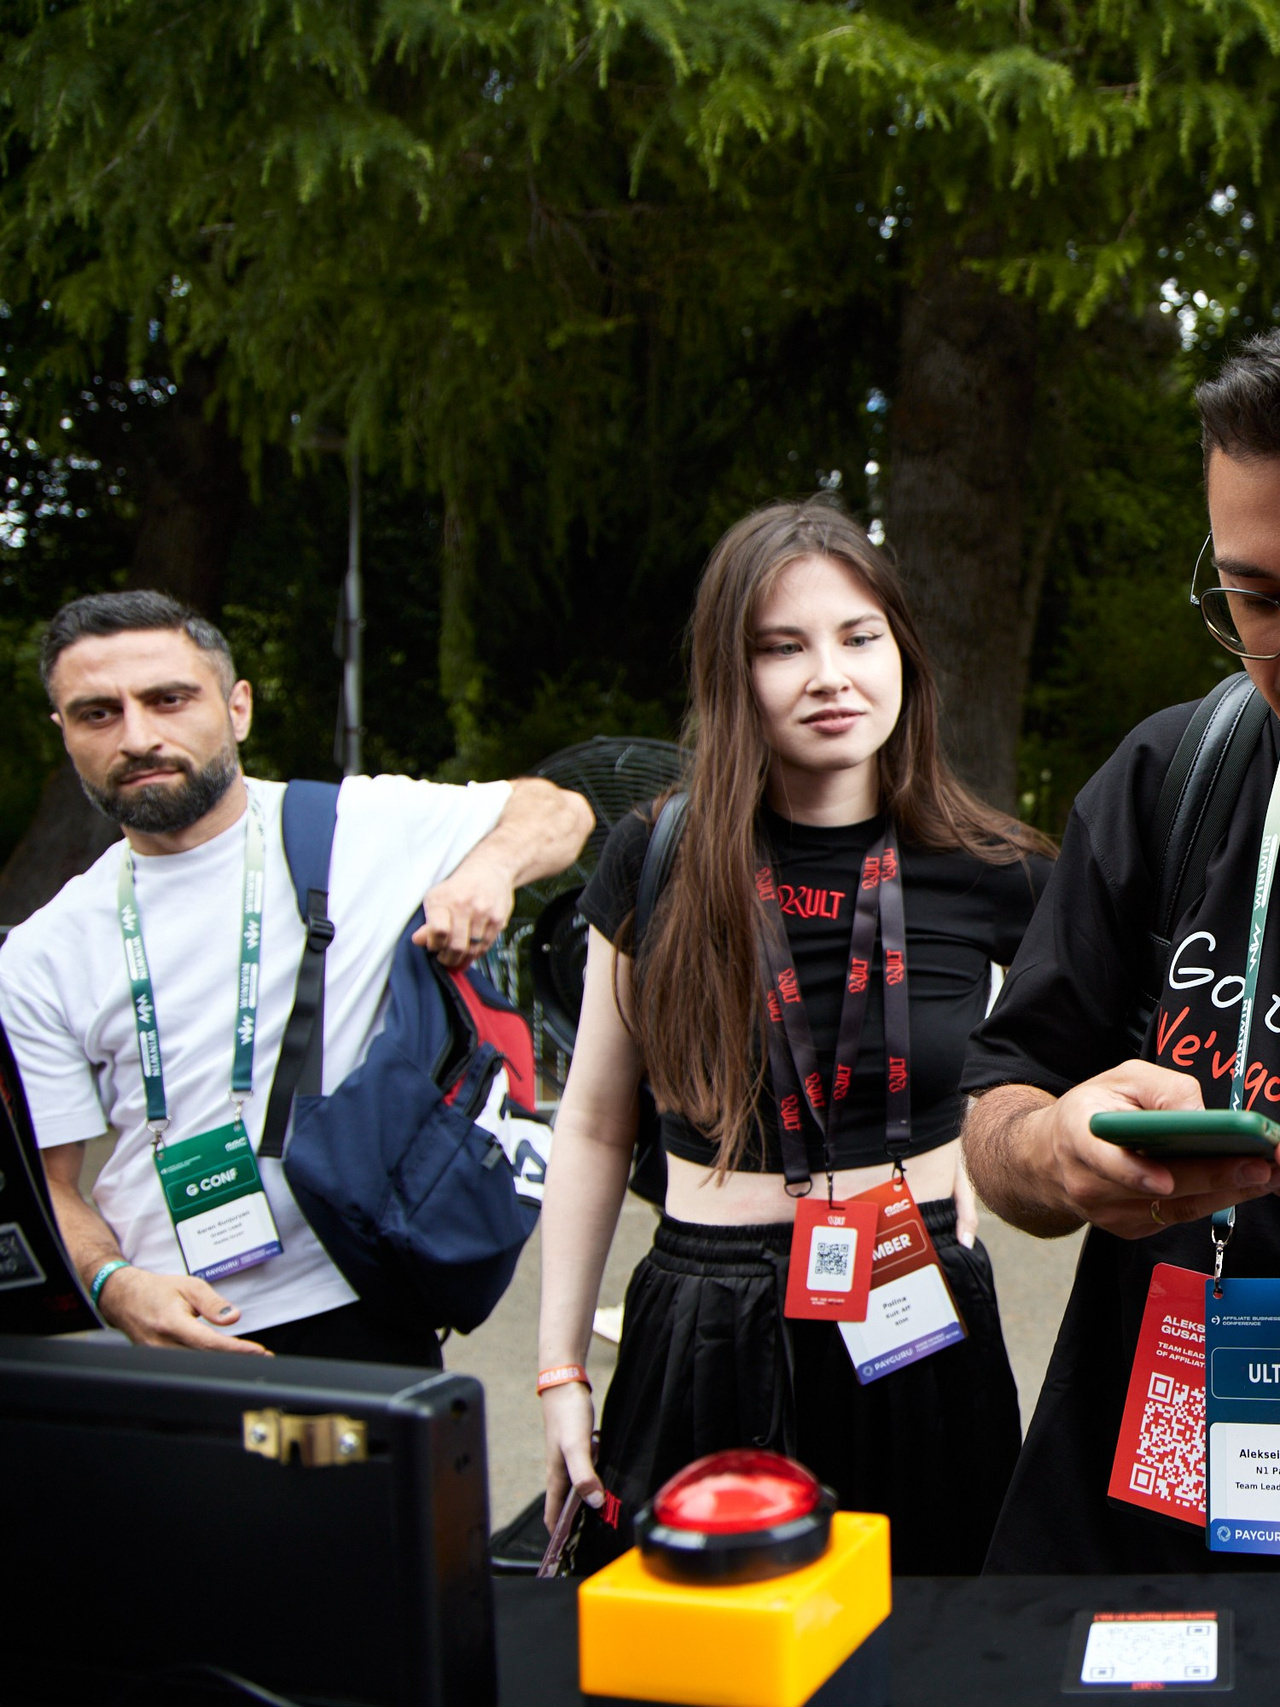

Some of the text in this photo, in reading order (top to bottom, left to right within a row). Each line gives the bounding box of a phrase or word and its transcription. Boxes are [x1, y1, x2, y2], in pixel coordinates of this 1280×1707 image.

[1254, 835, 1272, 911] WINWIN
[200, 1168, 238, 1191] CONF
[1156, 1349, 1168, 1357] OF
[1158, 1341, 1205, 1359] TEAM LEAD
[874, 1347, 913, 1371] PAYGURU
[1239, 1449, 1279, 1460] Aleksei
[1256, 1466, 1269, 1475] N1
[1235, 1481, 1258, 1490] Team
